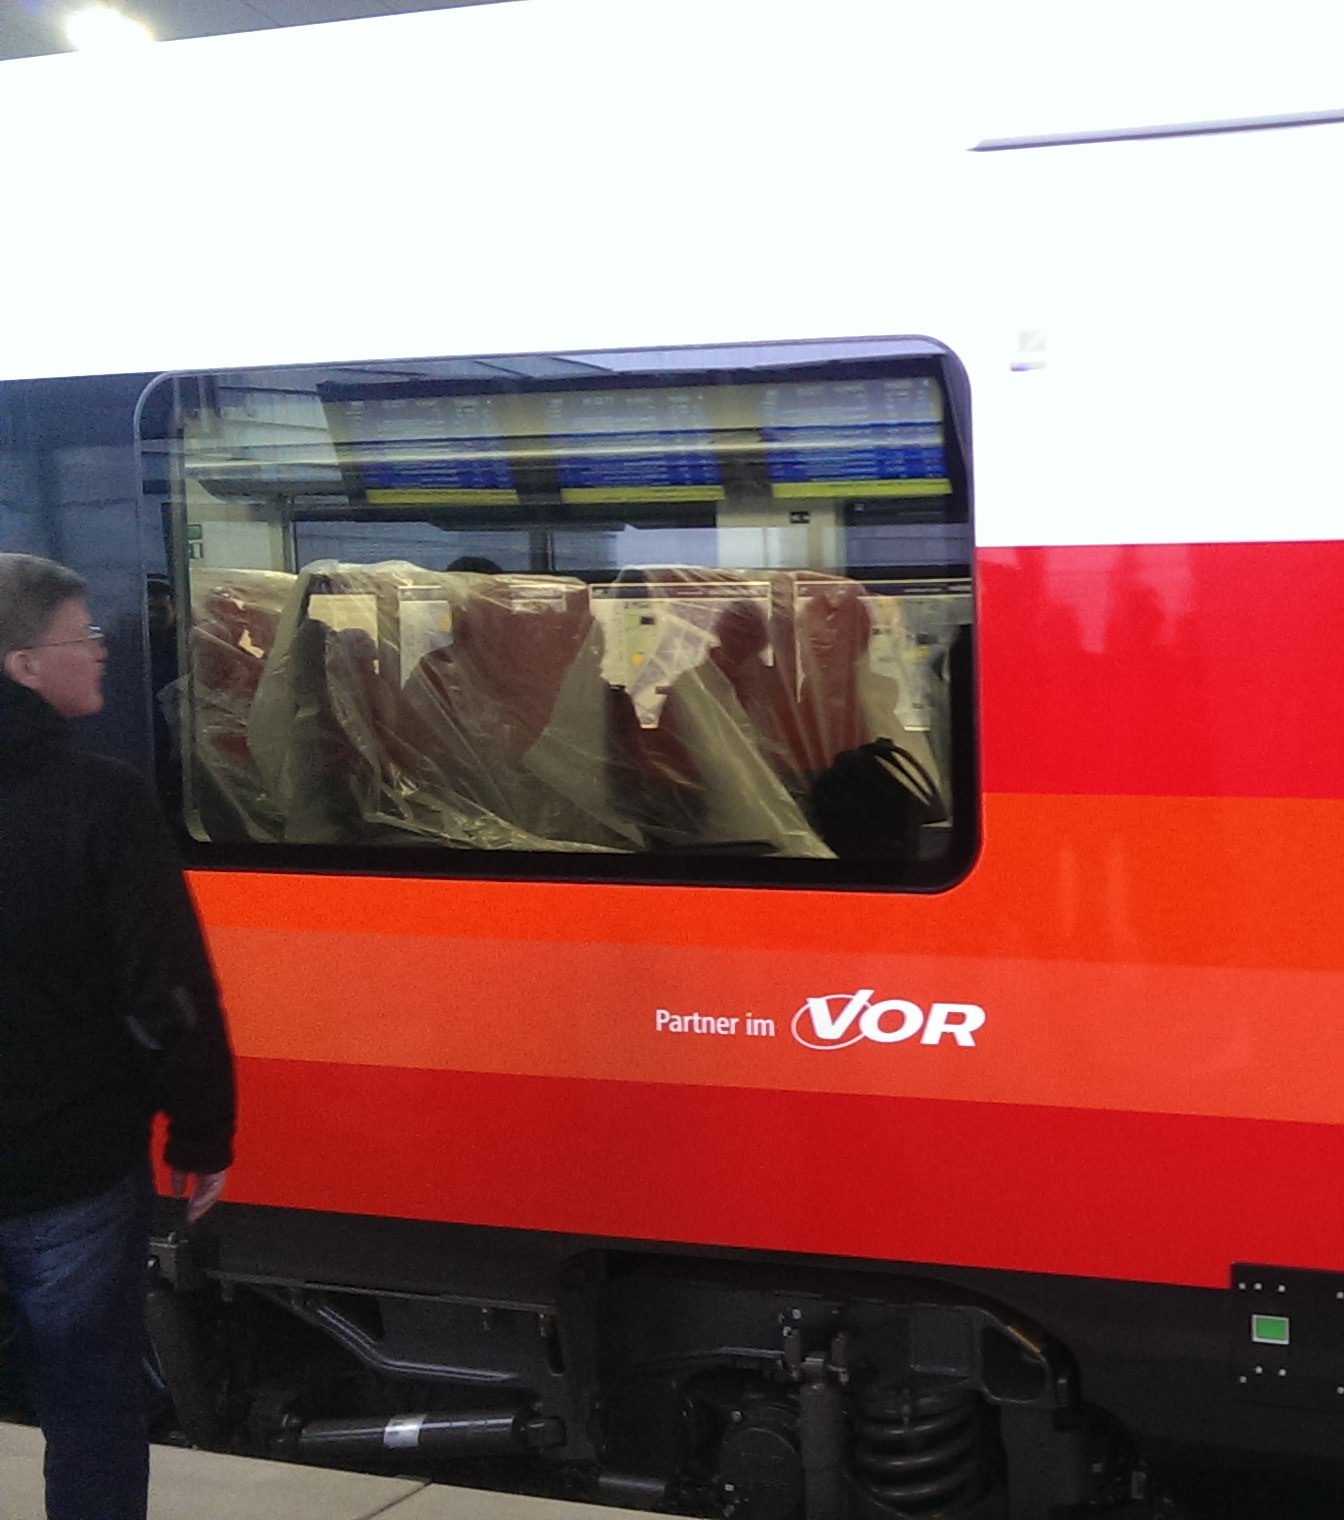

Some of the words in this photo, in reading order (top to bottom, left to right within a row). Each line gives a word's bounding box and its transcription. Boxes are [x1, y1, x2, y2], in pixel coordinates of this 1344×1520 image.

[655, 1009, 739, 1035] Partner
[746, 1012, 776, 1037] im
[805, 989, 986, 1047] VOR
